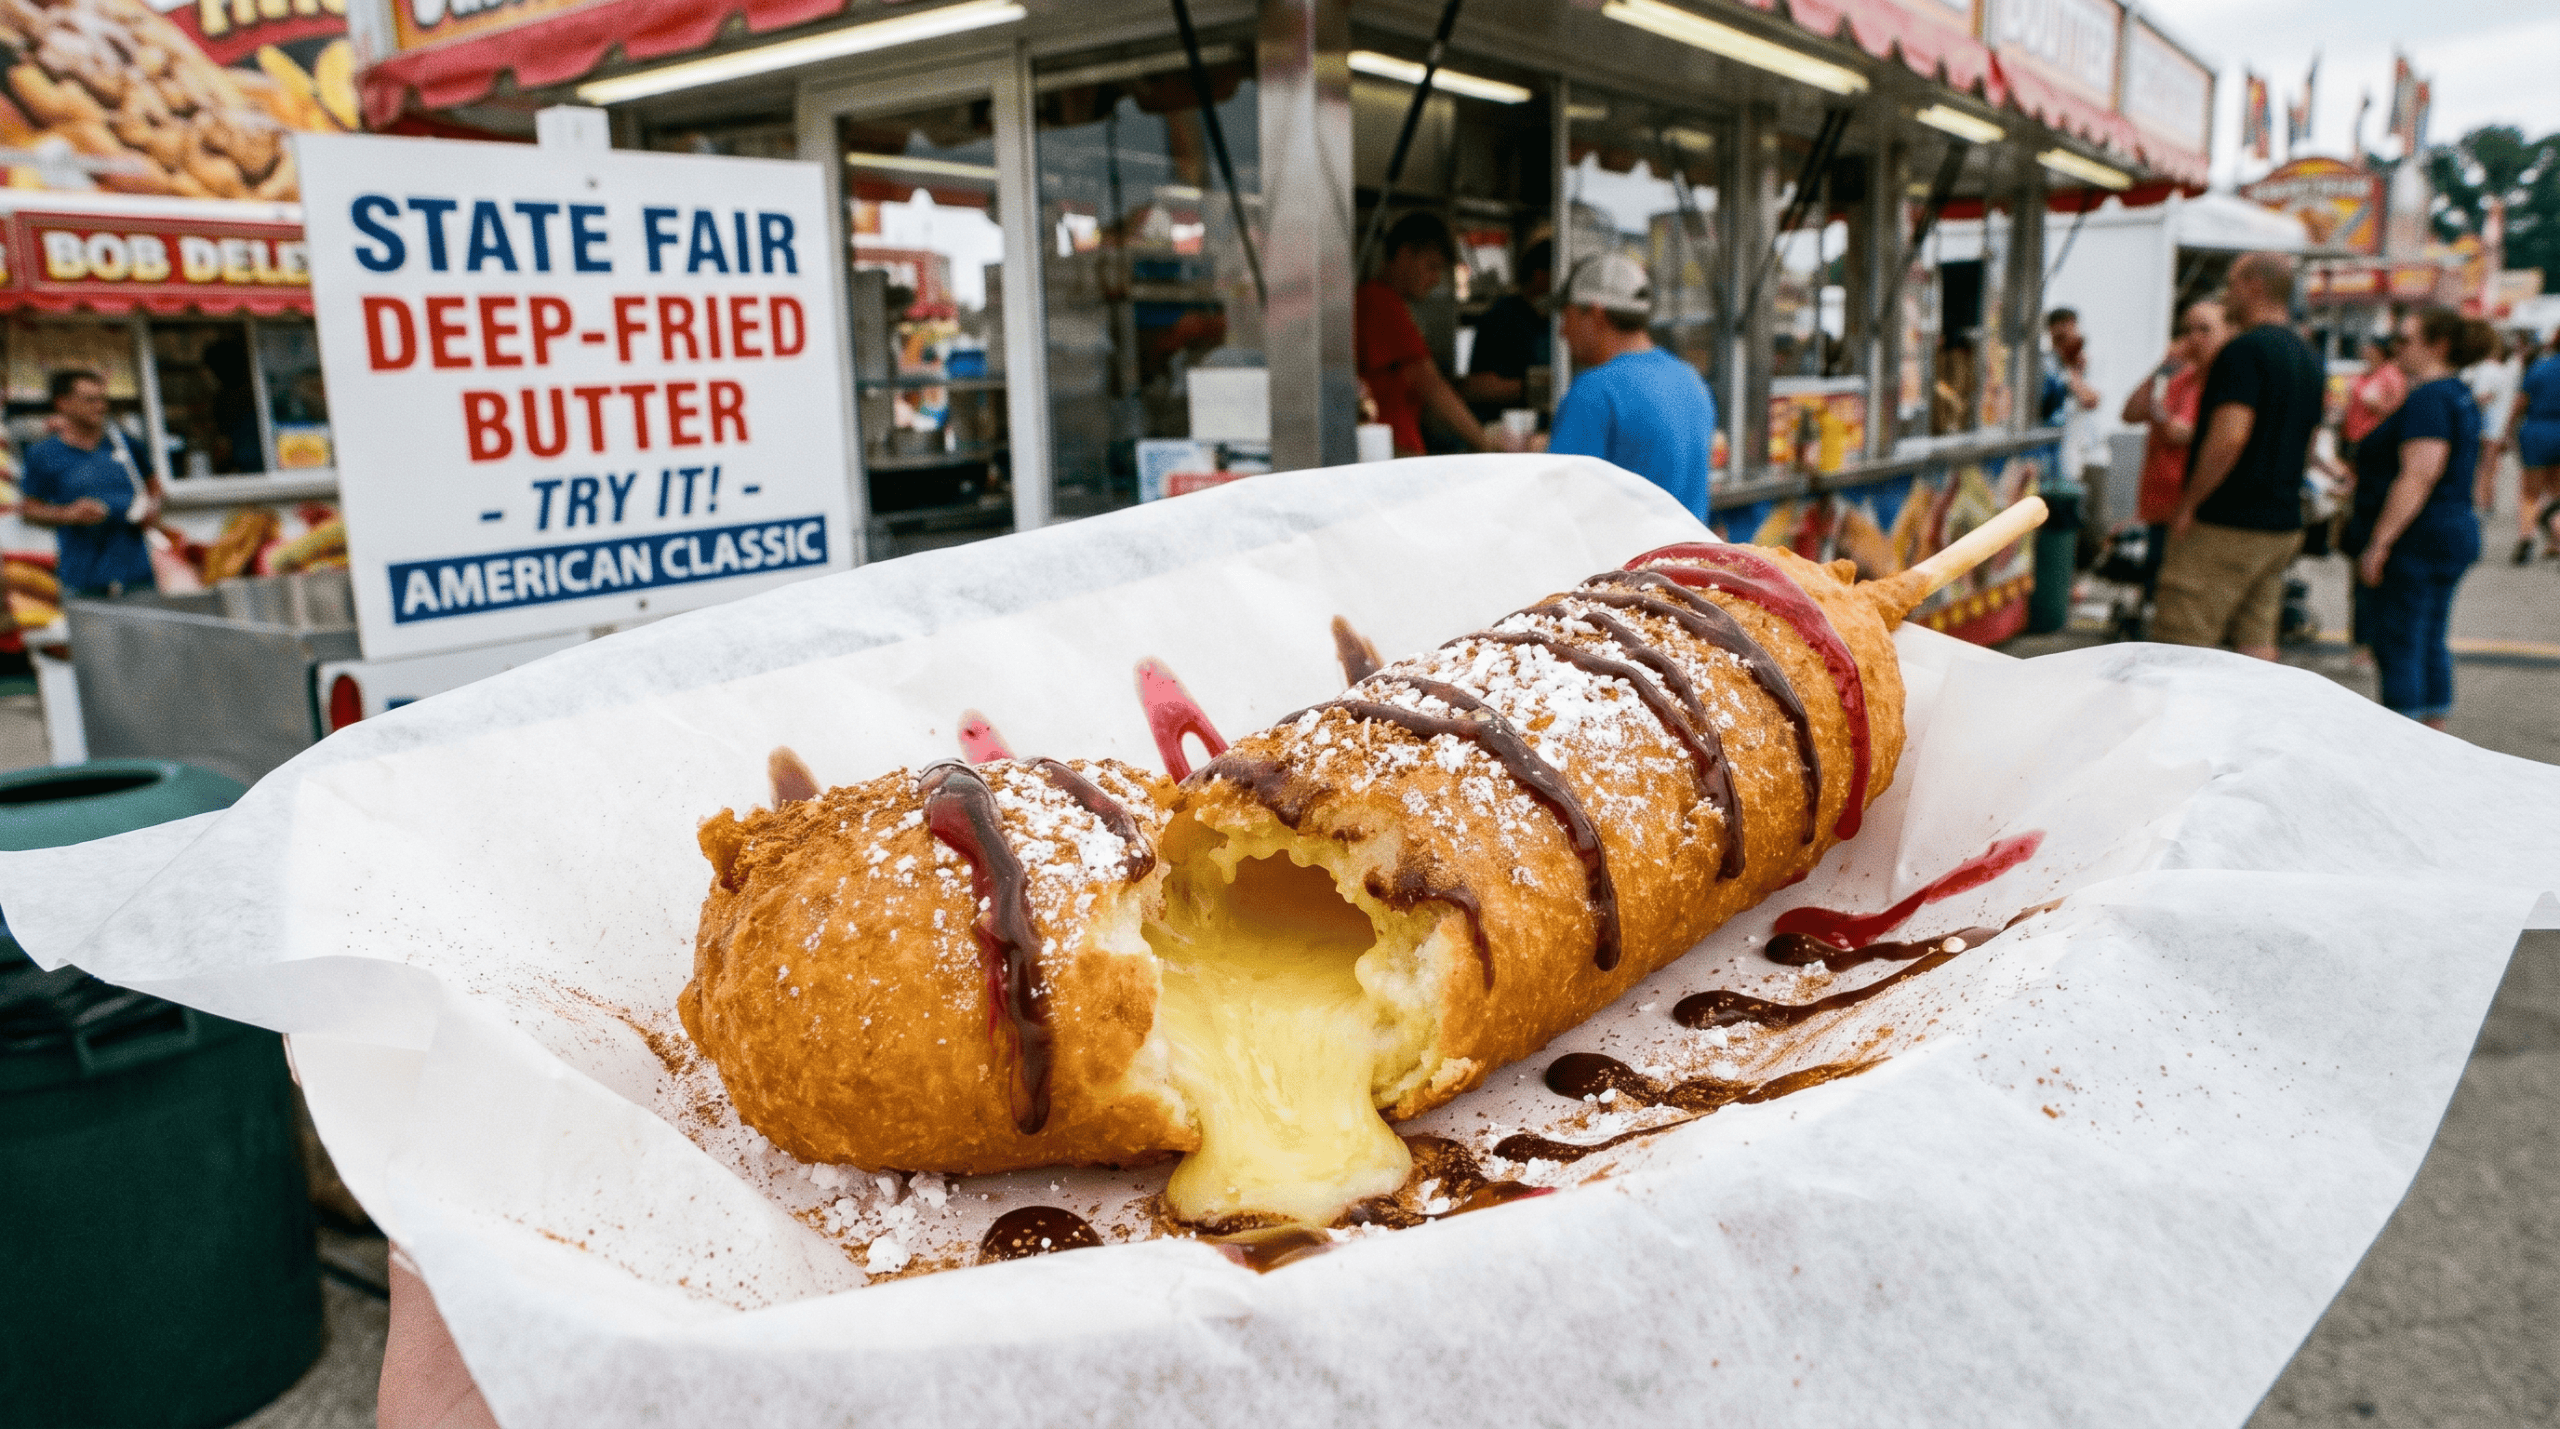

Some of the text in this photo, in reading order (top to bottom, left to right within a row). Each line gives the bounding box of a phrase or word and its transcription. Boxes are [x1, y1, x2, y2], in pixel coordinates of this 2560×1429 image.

[42, 230, 172, 283] BOB
[351, 194, 798, 275] STATE FAIR
[361, 295, 806, 372] DEEP-FRIED
[462, 381, 749, 462] BUTTER
[531, 472, 637, 531] TRY
[656, 465, 721, 519] IT!
[402, 520, 823, 615] AMERICAN CLASSIC
